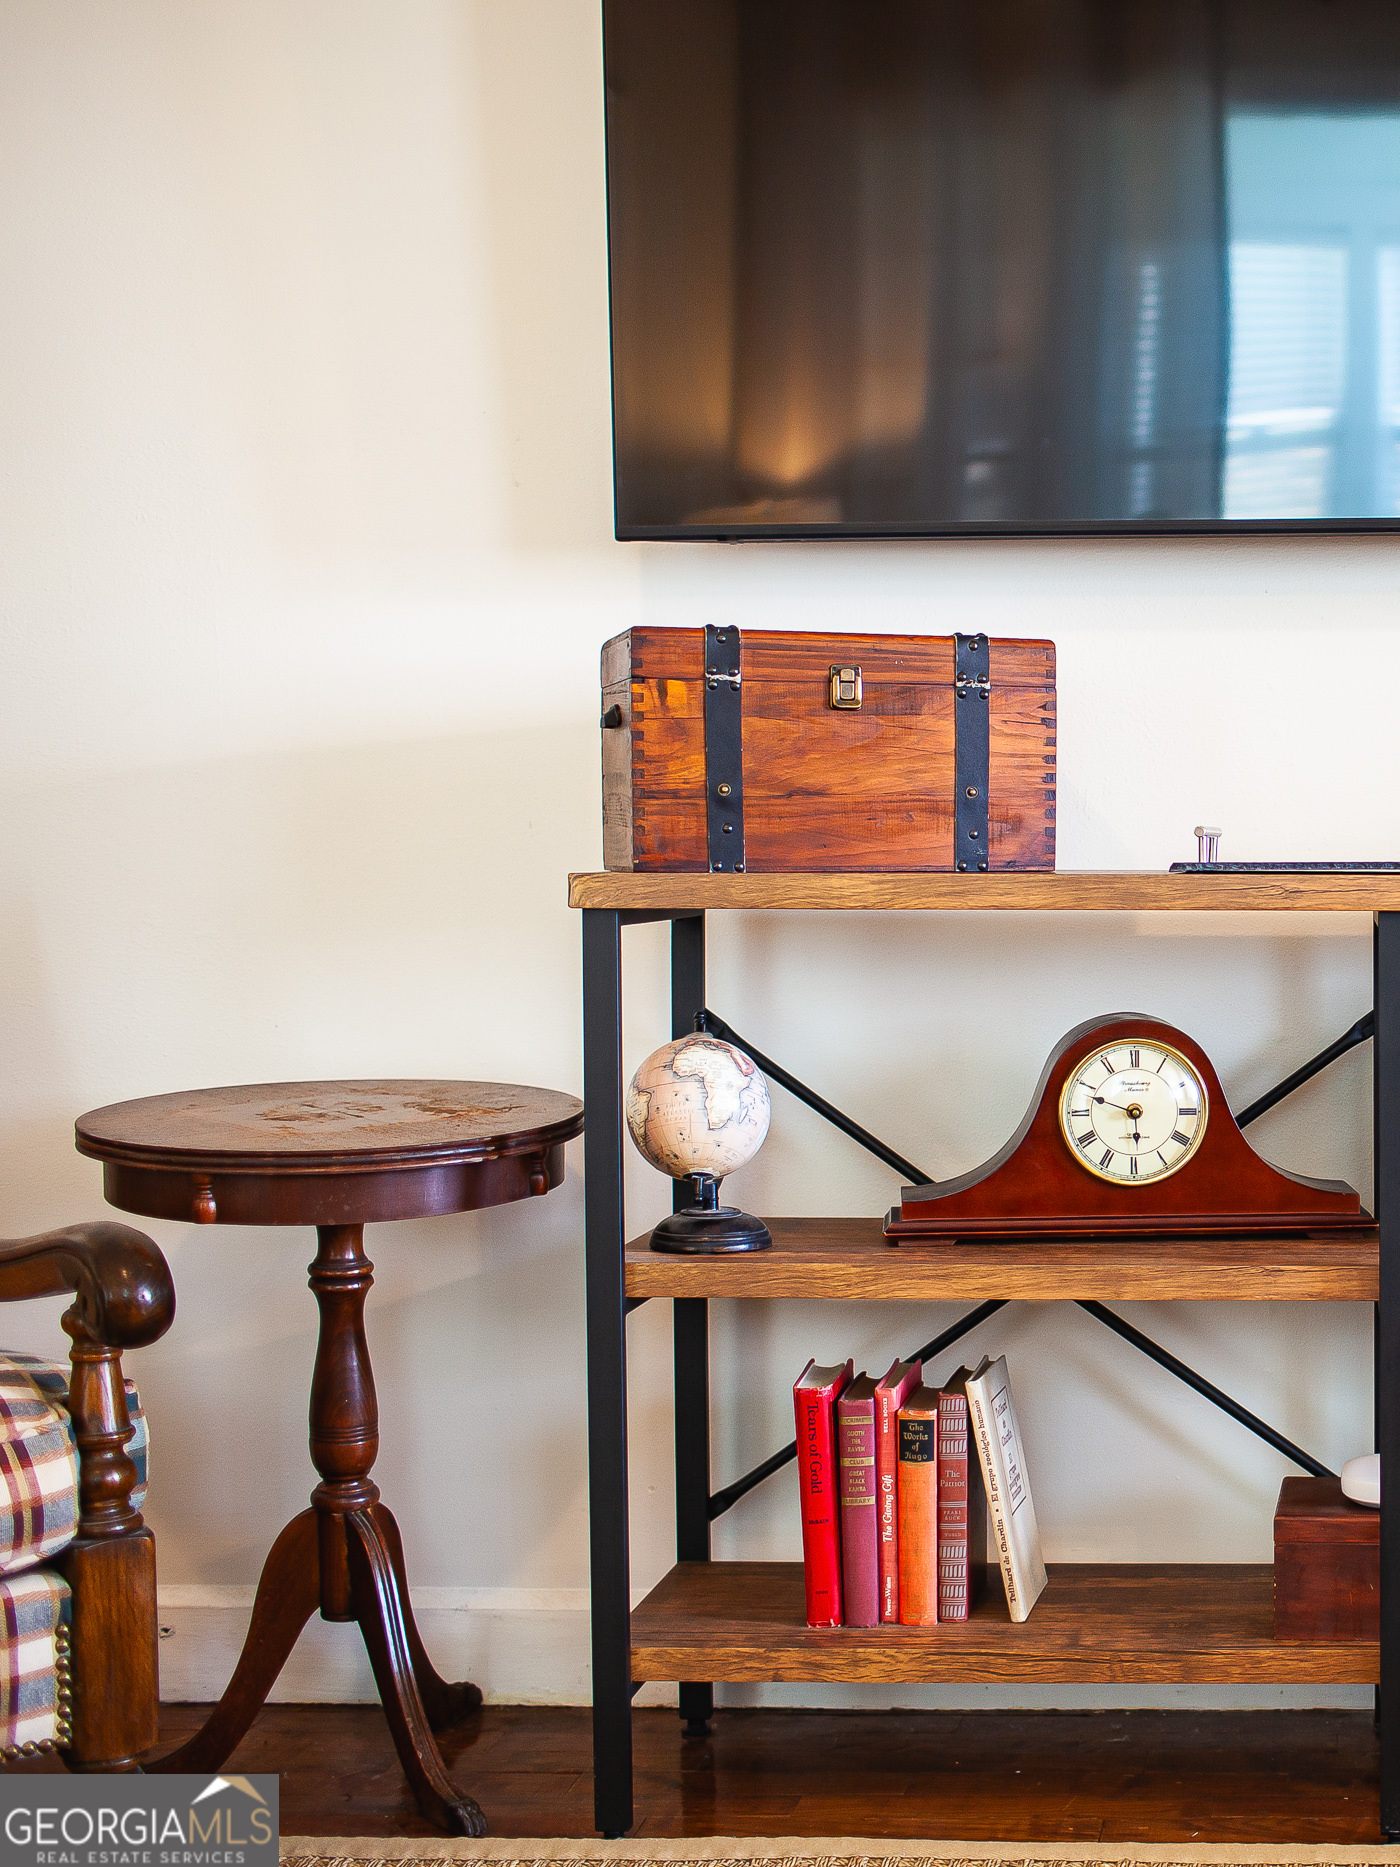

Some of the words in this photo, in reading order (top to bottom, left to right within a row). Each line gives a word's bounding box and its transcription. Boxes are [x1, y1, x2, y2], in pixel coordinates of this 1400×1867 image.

[806, 1401, 818, 1442] Tears
[974, 1400, 985, 1429] humano
[907, 1422, 924, 1431] The
[903, 1432, 929, 1440] Works
[810, 1443, 821, 1459] of
[911, 1442, 920, 1451] of
[904, 1452, 928, 1461] Hugo
[810, 1460, 823, 1494] Gold
[945, 1470, 961, 1478] The
[988, 1468, 998, 1492] grupo
[882, 1474, 892, 1493] Gift
[940, 1479, 965, 1487] Patriot
[991, 1493, 999, 1503] El
[882, 1494, 894, 1524] Giving
[882, 1525, 893, 1543] The
[997, 1519, 1008, 1553] Chardin
[1003, 1555, 1010, 1565] de
[1005, 1567, 1017, 1603] Teilhard
